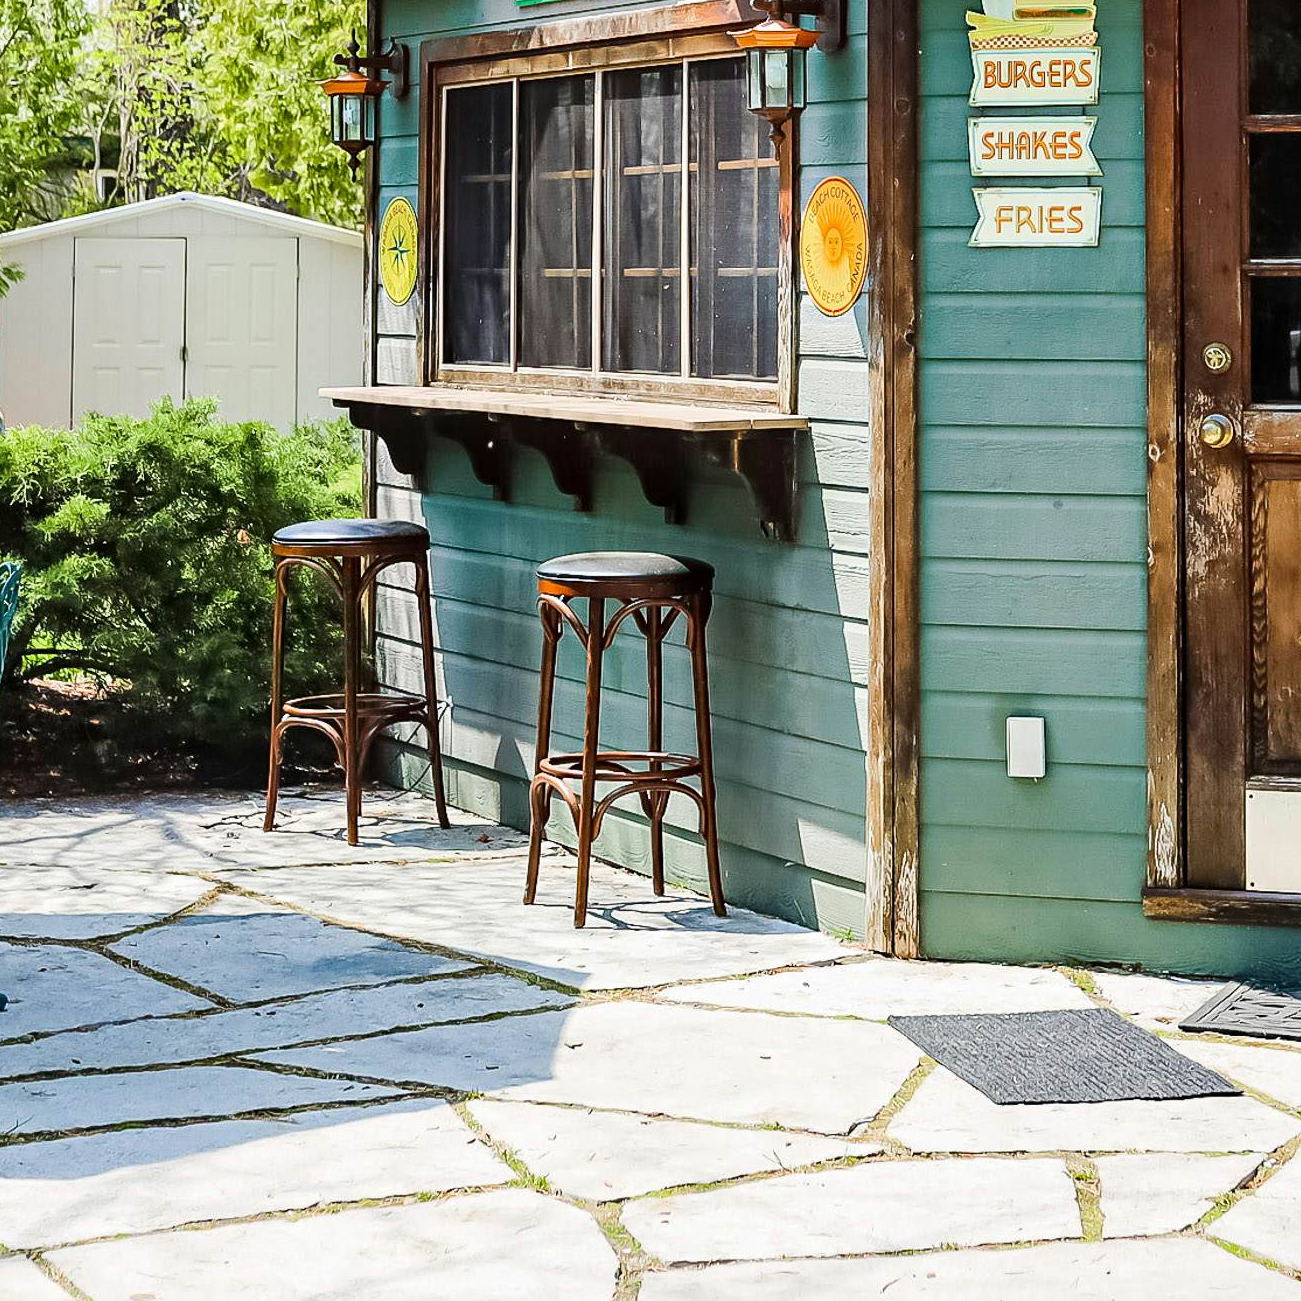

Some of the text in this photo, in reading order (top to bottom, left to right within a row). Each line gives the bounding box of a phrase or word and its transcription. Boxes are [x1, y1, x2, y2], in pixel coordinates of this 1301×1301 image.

[983, 59, 1093, 89] BURGERS
[981, 131, 1083, 160] SHAKES
[809, 186, 860, 224] BEACH COTTAGE
[994, 205, 1084, 234] FRIES
[805, 242, 863, 304] WASAGA BEACH CANADA
